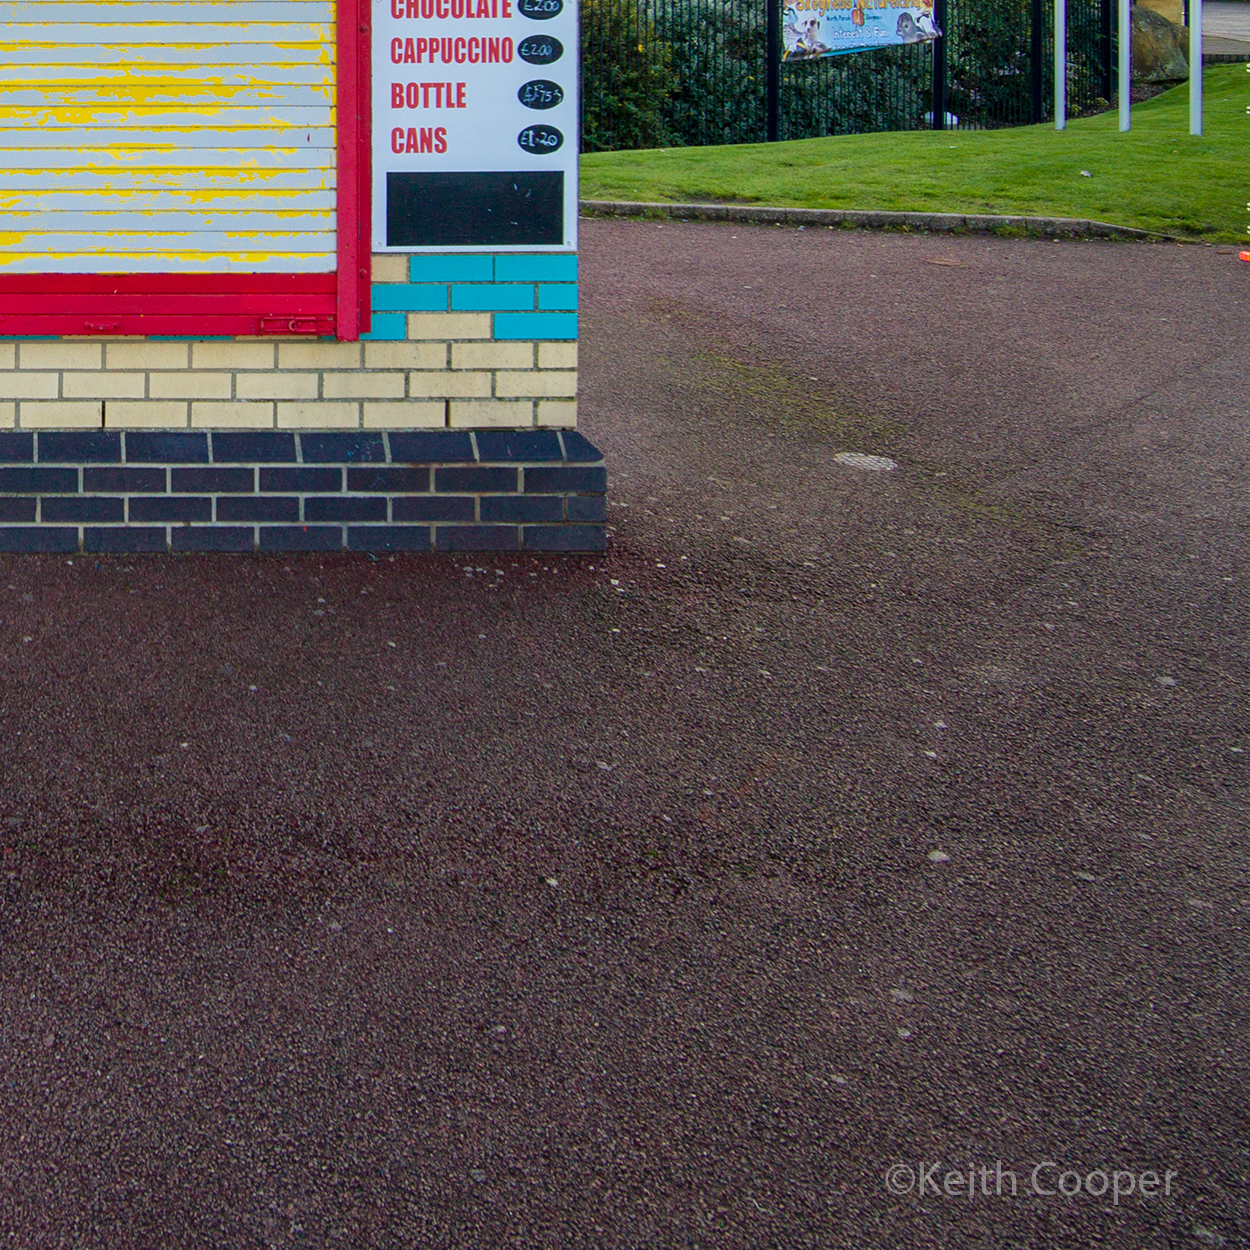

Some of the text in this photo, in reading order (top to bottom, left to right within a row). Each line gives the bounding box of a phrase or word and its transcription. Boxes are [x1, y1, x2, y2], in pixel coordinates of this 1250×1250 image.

[832, 26, 888, 40] Interest & Fun
[391, 37, 514, 64] CAPPUCCINO
[391, 82, 467, 109] BOTTLE
[391, 127, 448, 154] CANS
